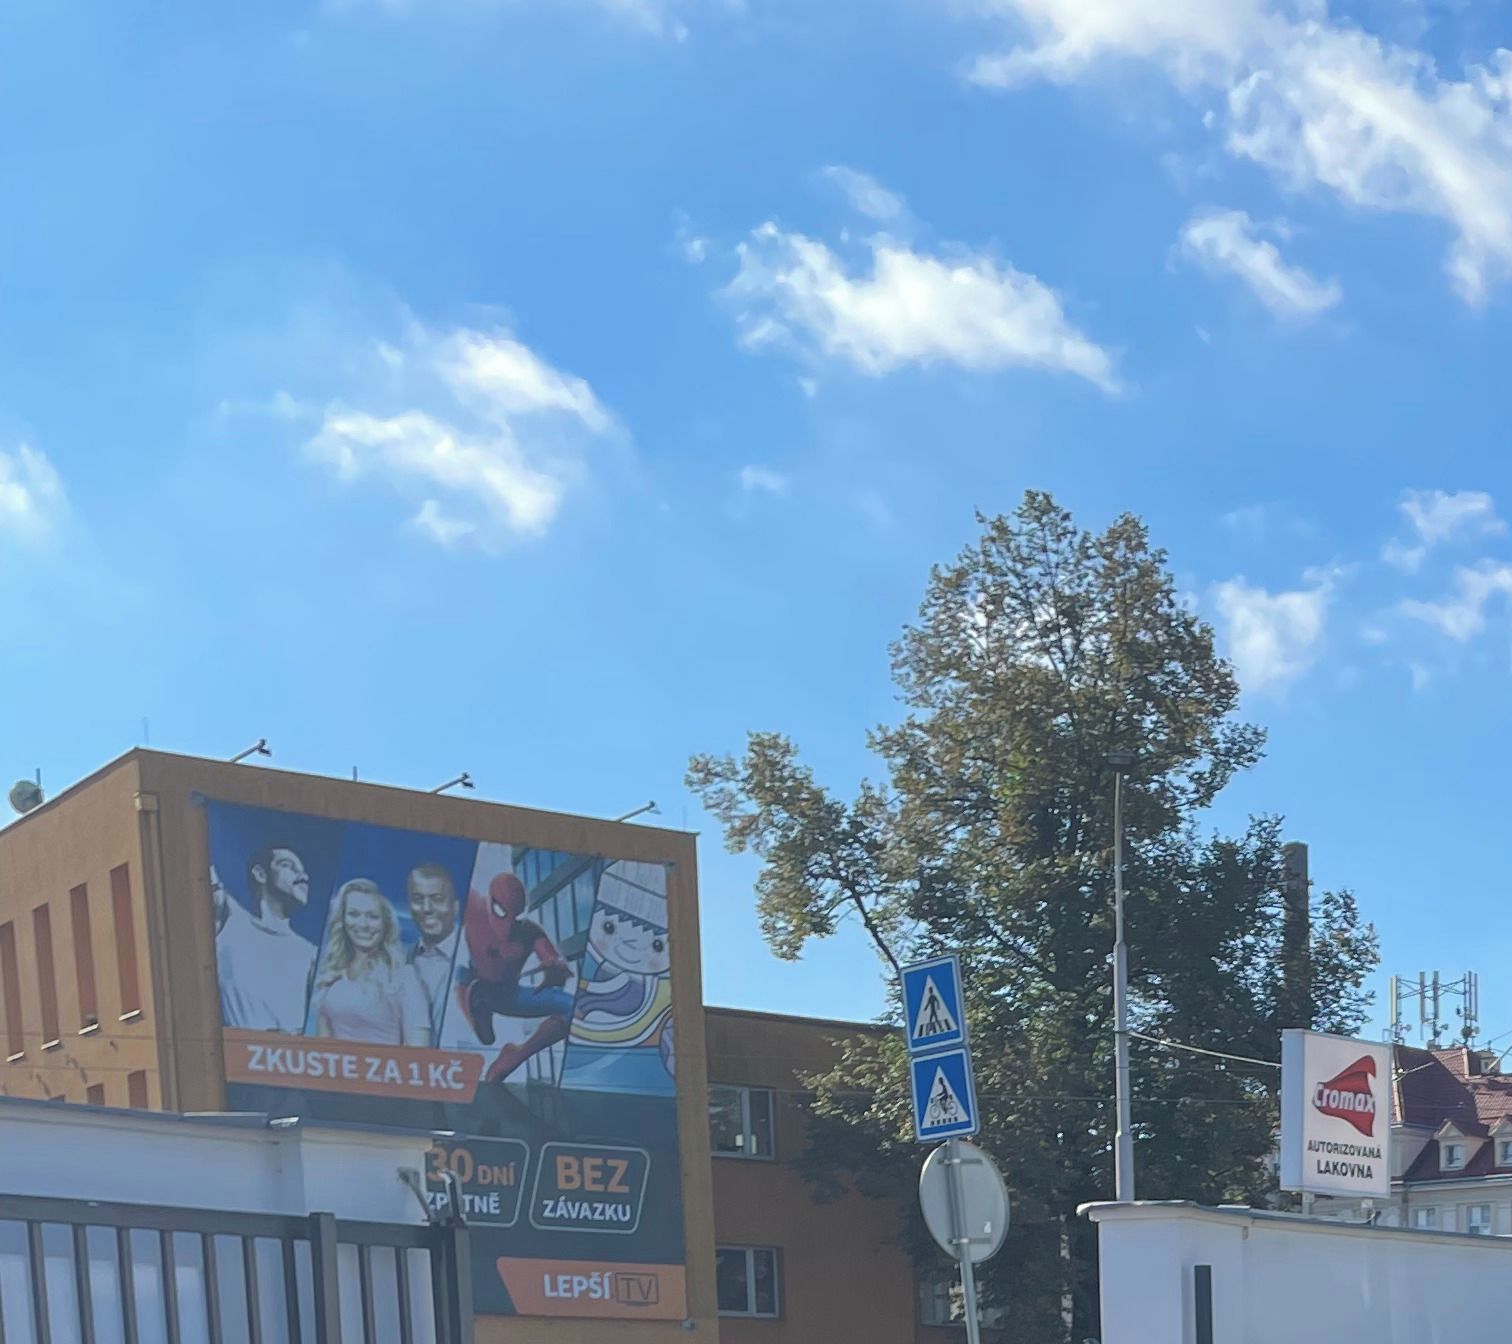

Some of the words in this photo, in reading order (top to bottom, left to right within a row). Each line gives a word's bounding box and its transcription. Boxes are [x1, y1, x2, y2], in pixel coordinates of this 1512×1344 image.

[247, 1044, 359, 1079] ZKUSTE
[364, 1056, 403, 1085] ZA
[408, 1061, 424, 1086] 1
[428, 1058, 465, 1090] KČ
[1312, 1083, 1375, 1113] Cromax
[1307, 1139, 1382, 1160] AUTORIZOVANÁ
[426, 1145, 474, 1183] 30
[477, 1161, 516, 1186] DNÍ
[555, 1154, 630, 1194] BEZ
[1316, 1160, 1374, 1179] LAKOVNA
[426, 1191, 501, 1214] ZPTNĚ
[542, 1195, 632, 1222] ZÁVAZKU
[543, 1271, 612, 1300] LEPŠÍ
[621, 1277, 653, 1300] TV
